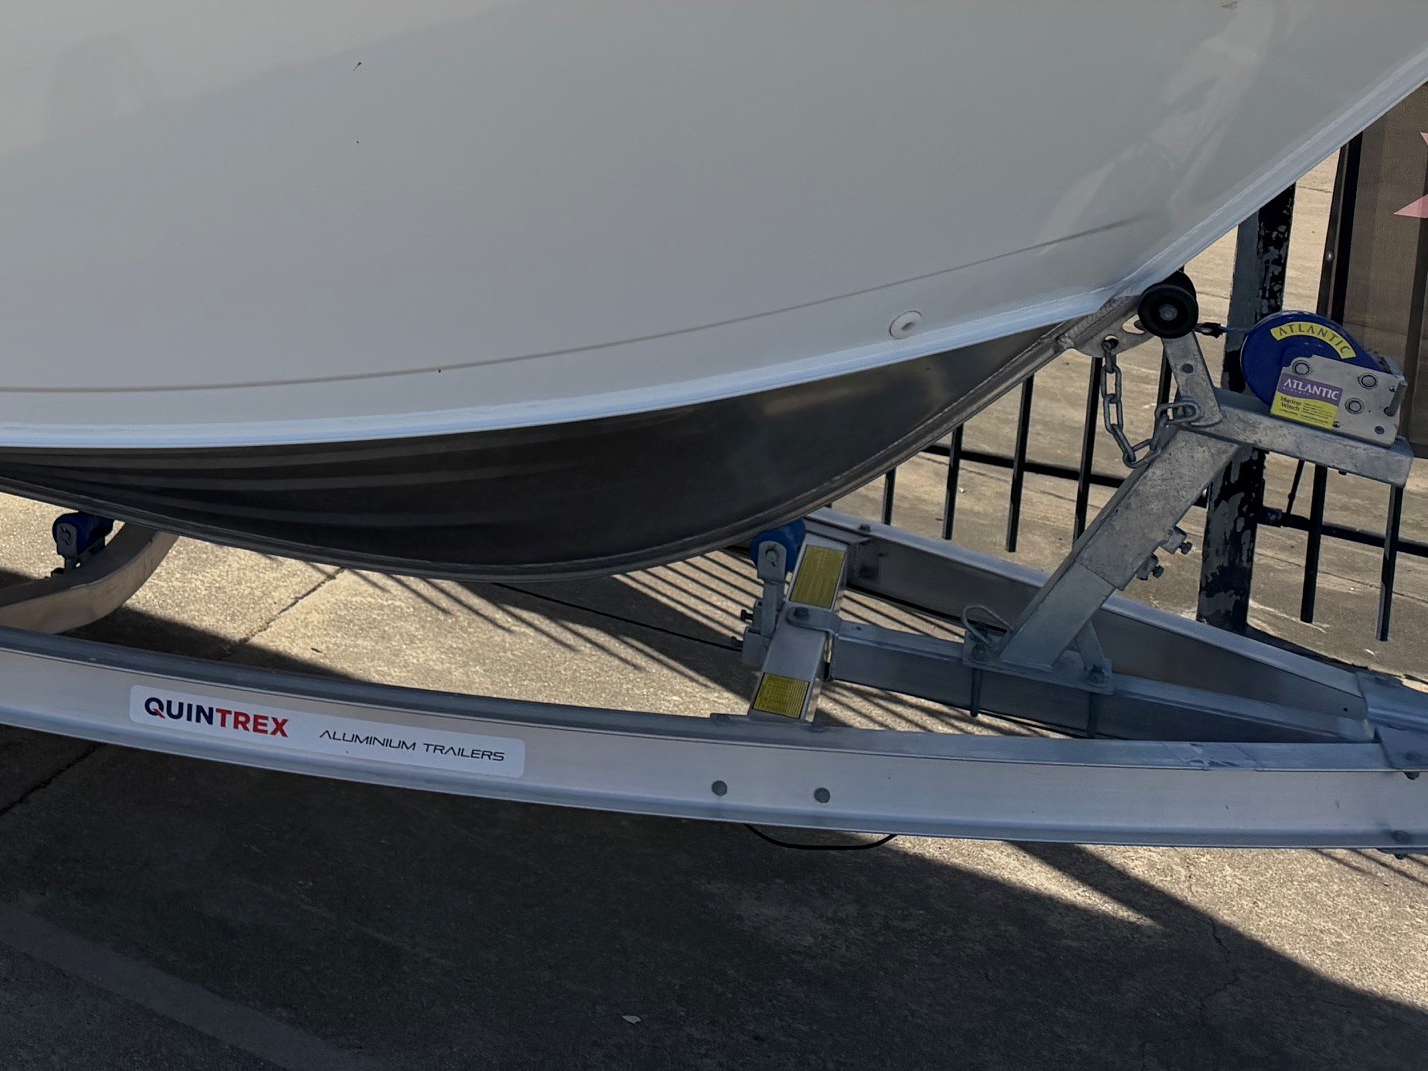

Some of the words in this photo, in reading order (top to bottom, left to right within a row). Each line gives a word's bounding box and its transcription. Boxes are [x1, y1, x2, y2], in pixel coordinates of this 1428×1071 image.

[1279, 323, 1351, 354] ATLANTIC
[1283, 378, 1340, 401] ATLANTIC
[144, 697, 289, 738] QUINTREX
[319, 730, 417, 751] ALUMINIUM
[423, 742, 506, 762] TRAILERS
